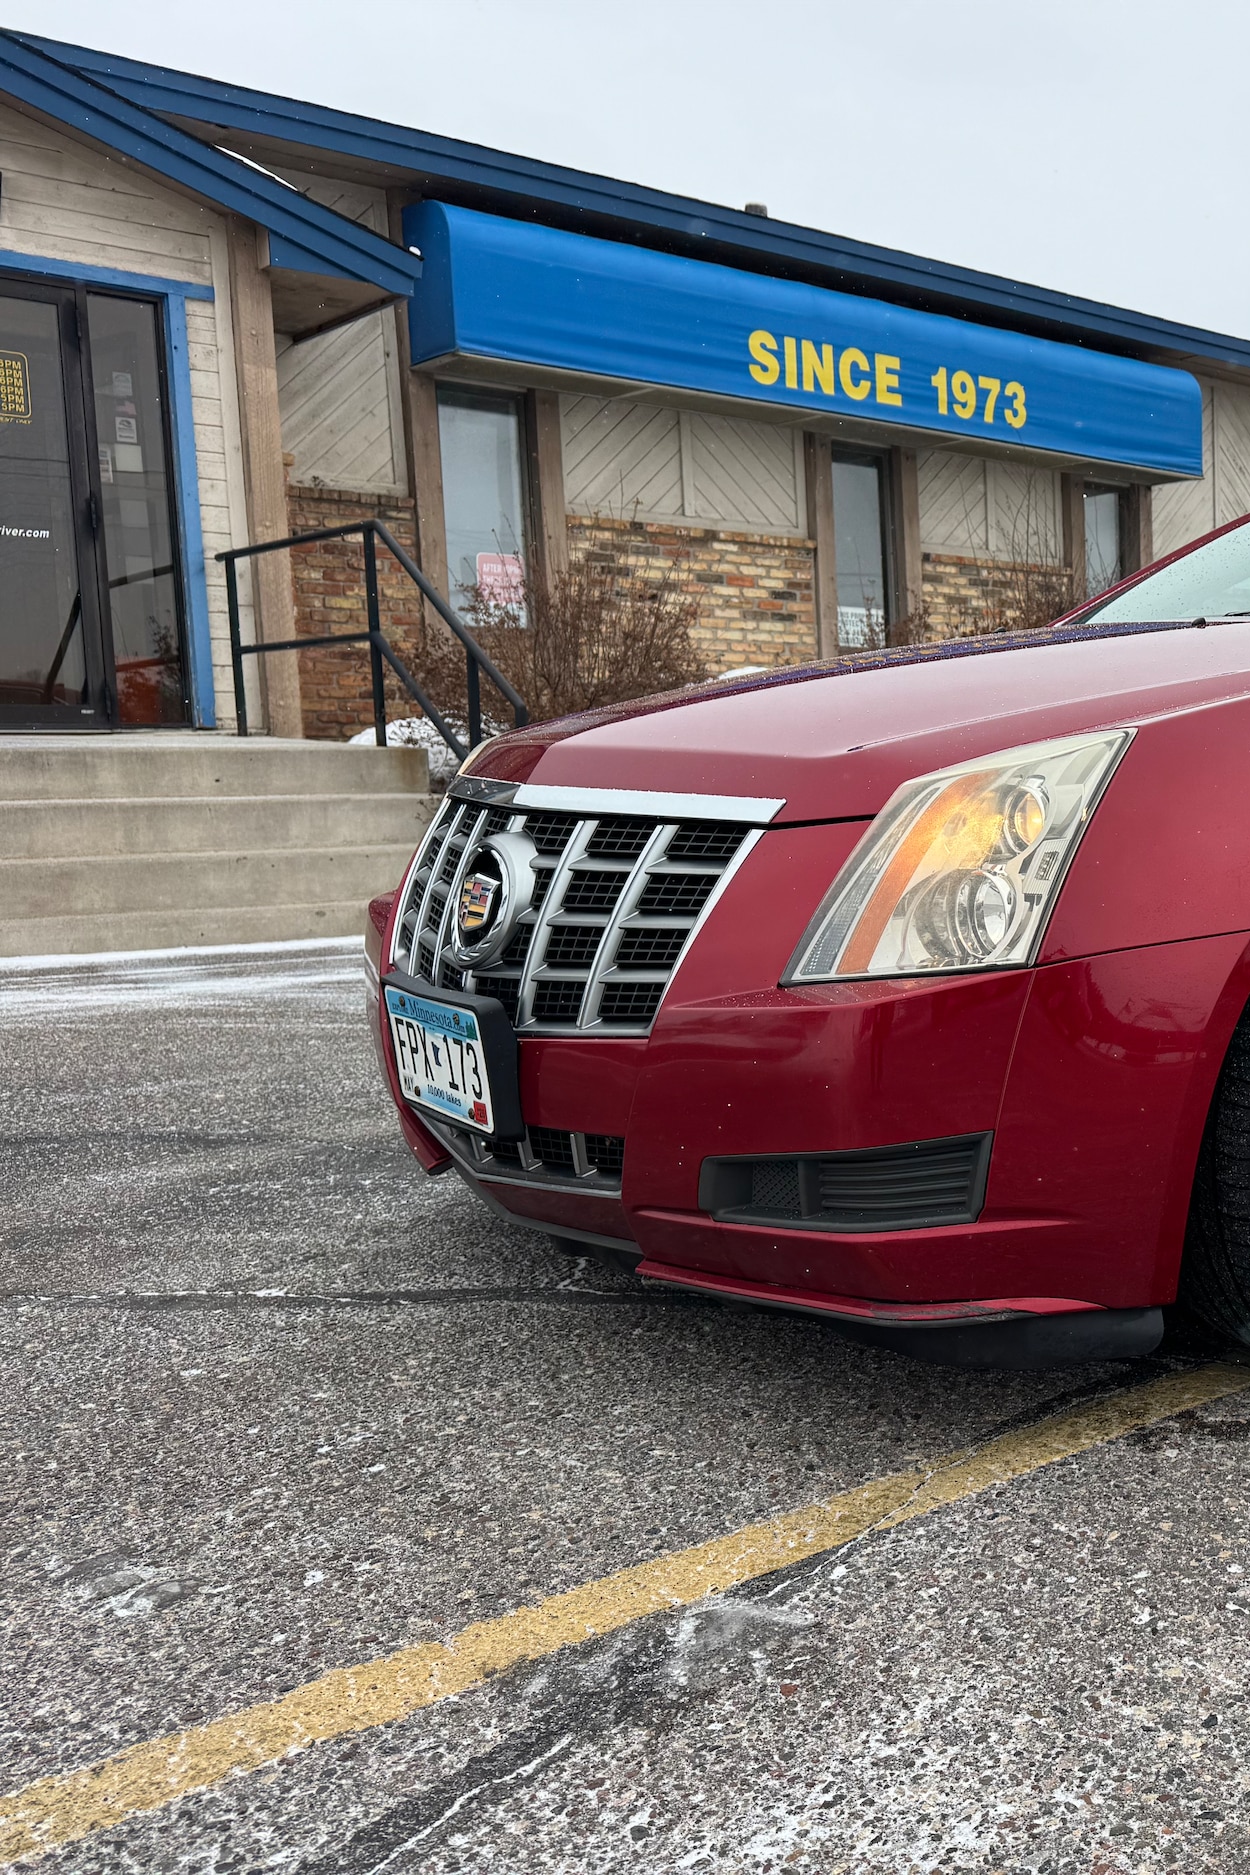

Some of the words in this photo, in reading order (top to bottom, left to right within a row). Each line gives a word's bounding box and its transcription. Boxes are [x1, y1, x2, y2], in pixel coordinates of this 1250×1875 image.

[748, 330, 902, 406] SINCE
[931, 366, 1027, 429] 1973
[0, 385, 24, 396] 6PM
[1, 393, 24, 404] 5PM
[1, 402, 25, 413] 5PM
[0, 525, 50, 538] iver.com
[394, 1017, 435, 1082] FPX
[442, 1033, 483, 1101] 173
[403, 1075, 415, 1093] MAY
[427, 1083, 446, 1101] 10,000
[445, 1090, 462, 1107] lakes
